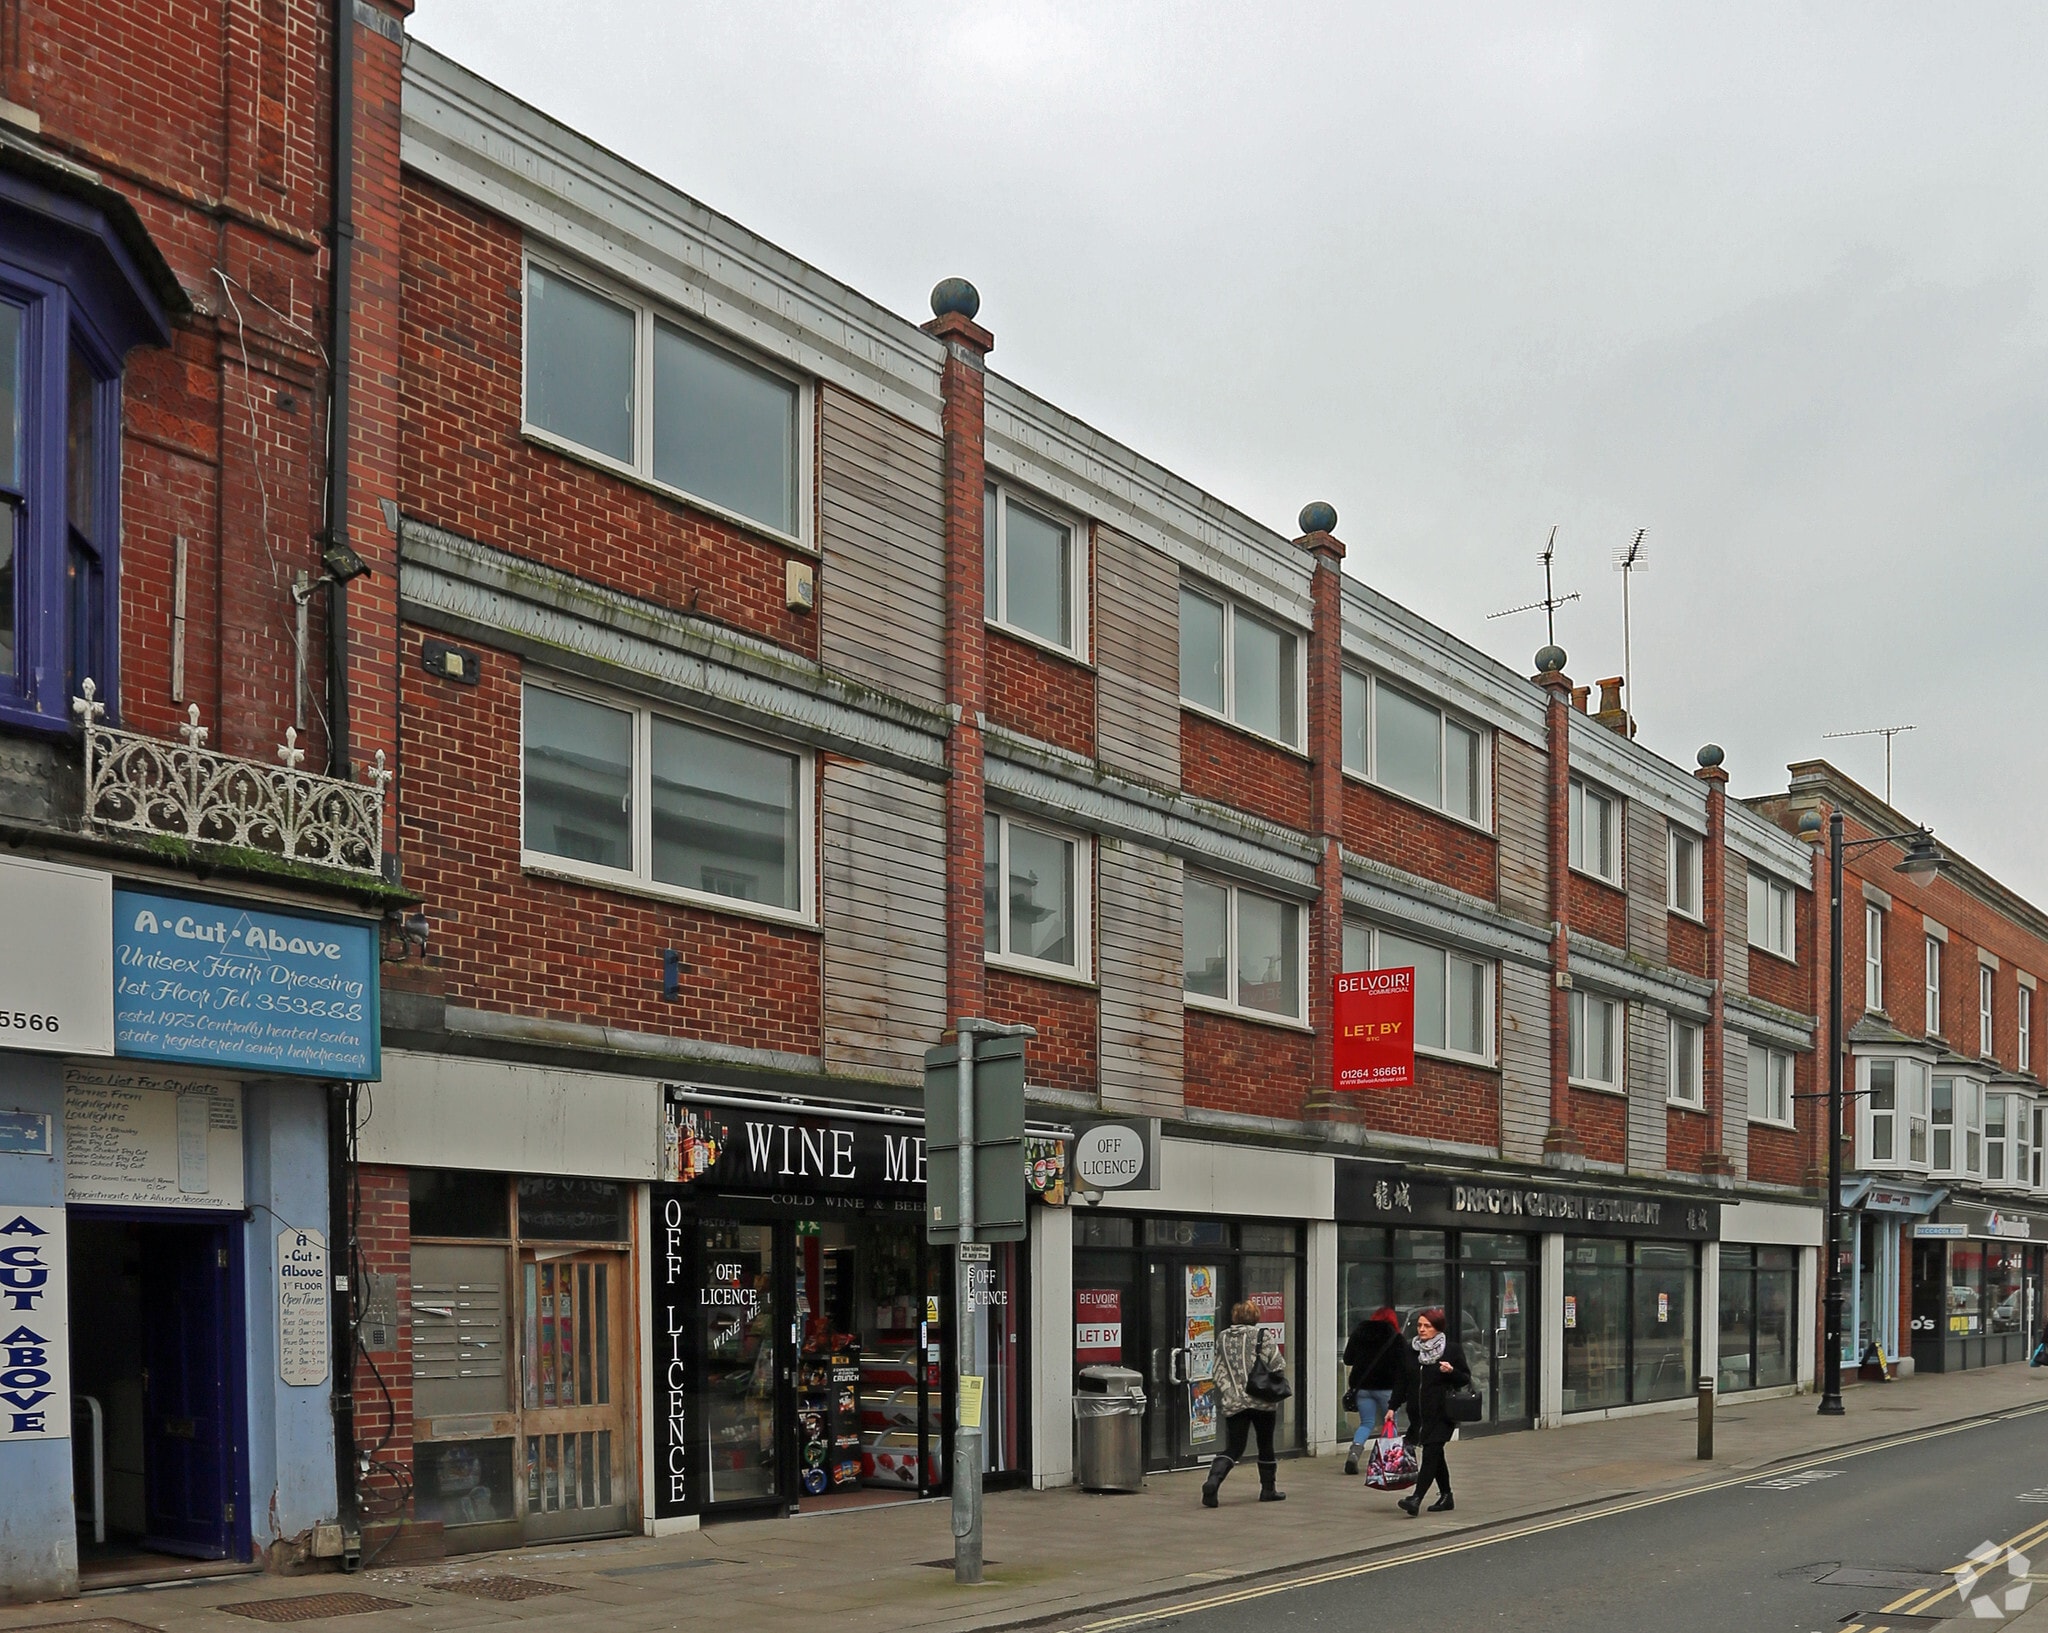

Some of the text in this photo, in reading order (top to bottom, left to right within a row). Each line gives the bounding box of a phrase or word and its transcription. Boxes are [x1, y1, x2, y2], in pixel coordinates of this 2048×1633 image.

[116, 944, 363, 1000] Unisex Hair Dressing
[1338, 973, 1410, 993] BELVOIR!
[118, 976, 362, 1021] 1st Floor Tel. 353888
[117, 1010, 360, 1046] estd. 1975 Centrally heated salon
[1344, 1022, 1402, 1037] LET BY
[118, 1029, 366, 1069] state registered senior hairdresser
[1341, 1066, 1406, 1079] 01264 366611
[65, 1069, 220, 1096] Price List For Stylists
[65, 1098, 129, 1112] Highlights
[65, 1109, 126, 1123] Lowlights
[745, 1121, 856, 1179] WINE
[1097, 1138, 1122, 1153] OFF
[1083, 1159, 1137, 1175] LICENCE
[771, 1194, 815, 1206] COLD
[824, 1198, 865, 1209] WINE
[873, 1200, 884, 1209] &
[1456, 1186, 1523, 1215] DRAGON
[296, 1234, 307, 1246] A
[292, 1249, 312, 1261] Cut
[281, 1264, 323, 1277] Above
[716, 1263, 742, 1281] OFF
[976, 1269, 997, 1284] OFF
[294, 1282, 322, 1290] FLOOR
[701, 1288, 758, 1305] LICENCE
[975, 1290, 1008, 1305] CENCE
[1079, 1293, 1119, 1305] BELVOIR!
[712, 1318, 741, 1350] WINE
[1079, 1329, 1119, 1343] LET BY
[665, 1199, 686, 1503] OFF LICENCE
